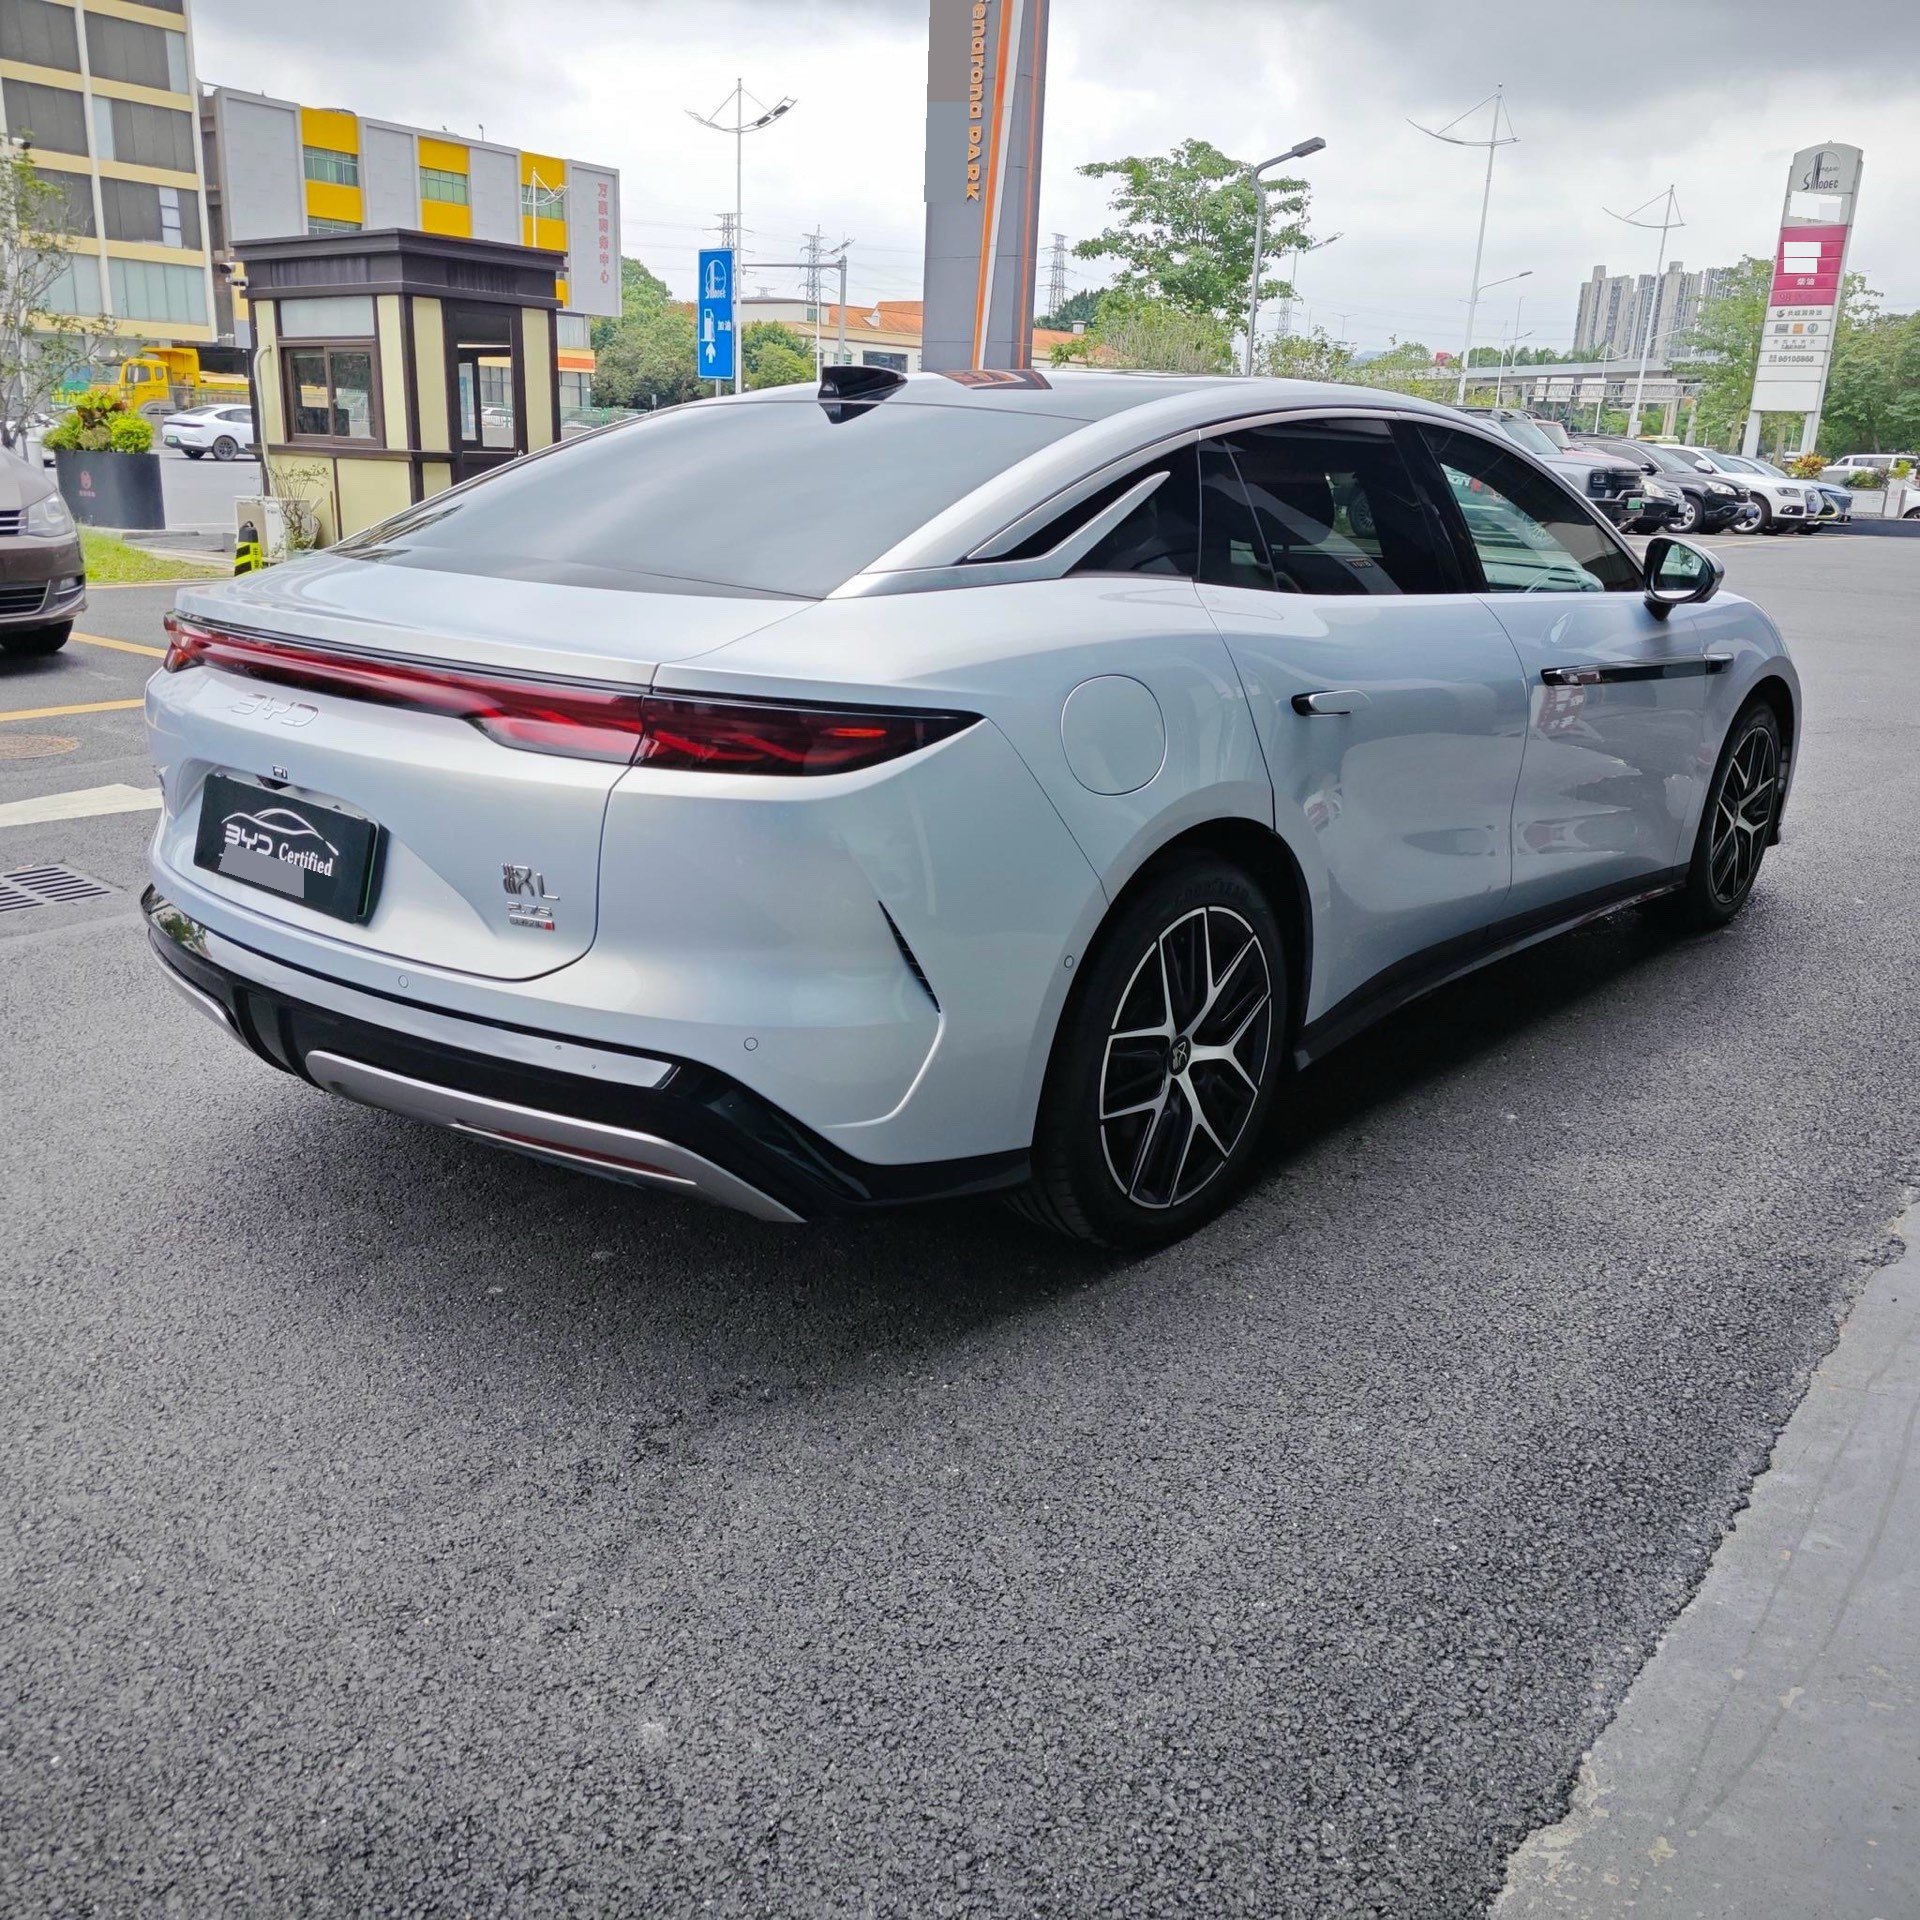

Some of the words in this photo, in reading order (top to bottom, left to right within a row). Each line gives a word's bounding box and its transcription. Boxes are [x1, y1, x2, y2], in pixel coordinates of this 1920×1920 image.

[230, 693, 319, 728] BYD
[224, 823, 274, 856] BYD
[278, 842, 334, 877] Certified
